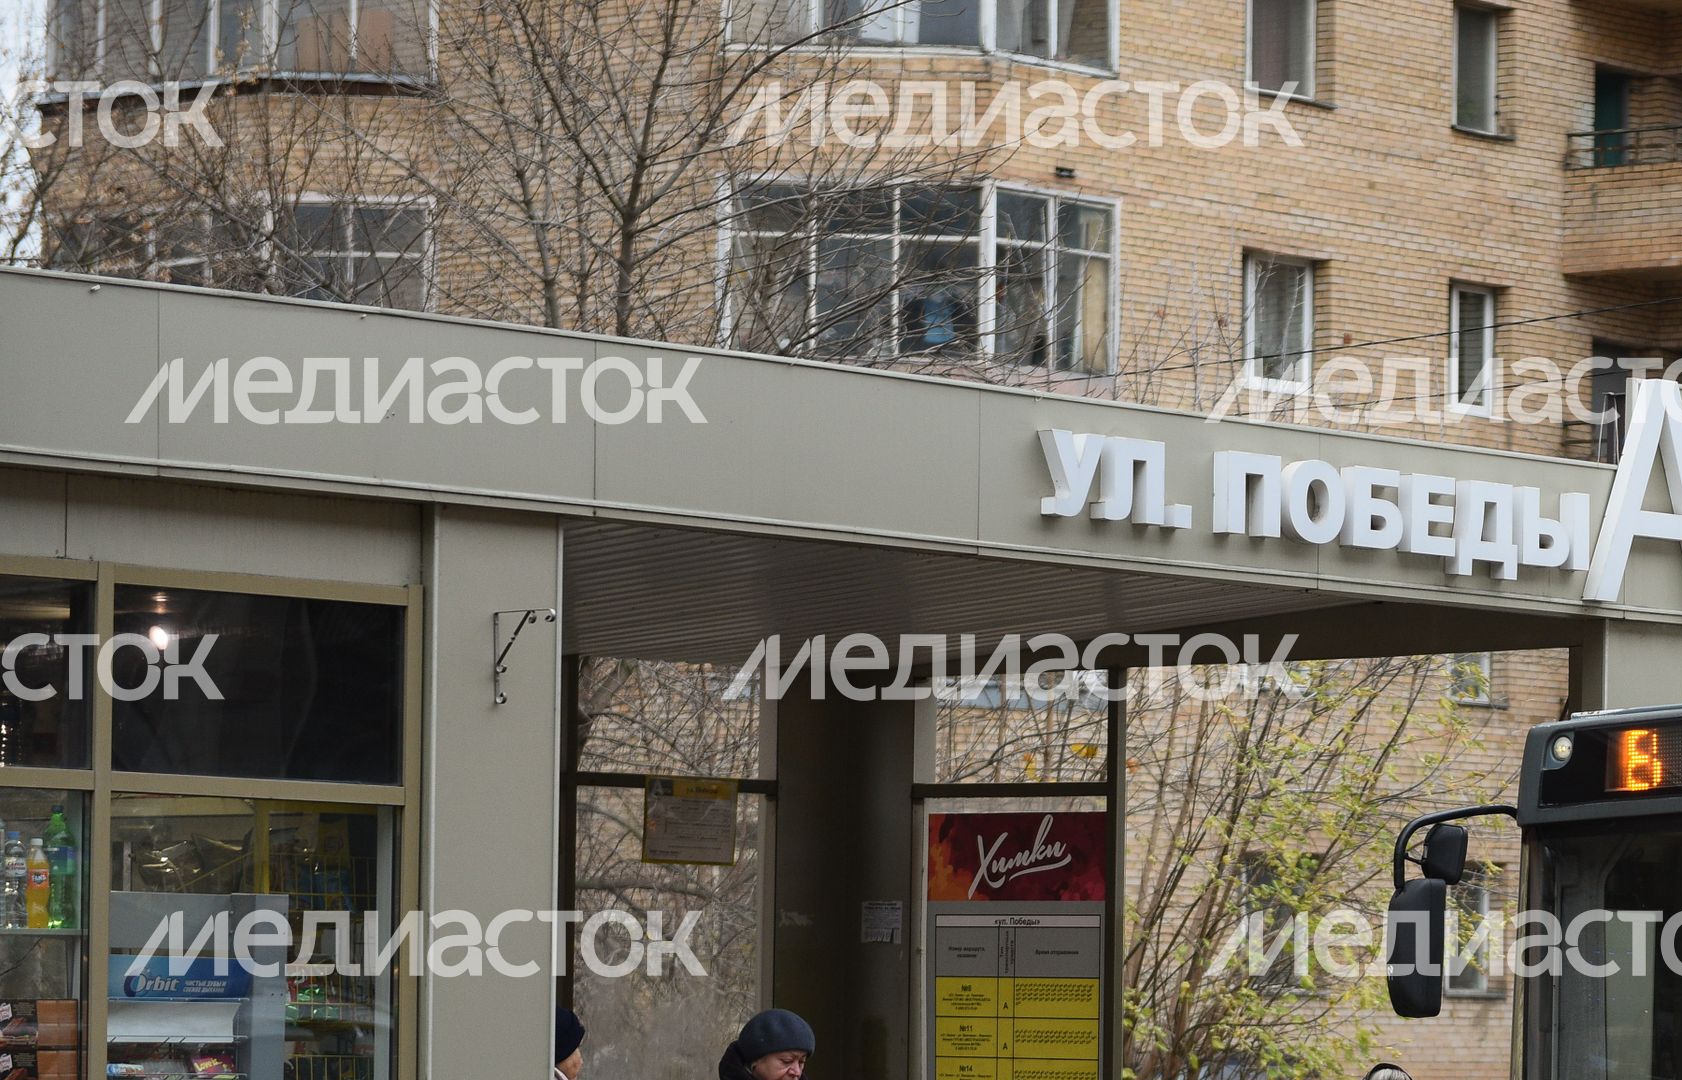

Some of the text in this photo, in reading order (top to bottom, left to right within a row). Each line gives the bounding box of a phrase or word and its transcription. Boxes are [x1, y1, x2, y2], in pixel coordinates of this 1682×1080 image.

[1037, 427, 1590, 581] УЛ. ПОБЕДЫ
[968, 814, 1072, 900] Химки
[124, 973, 180, 997] Orbit
